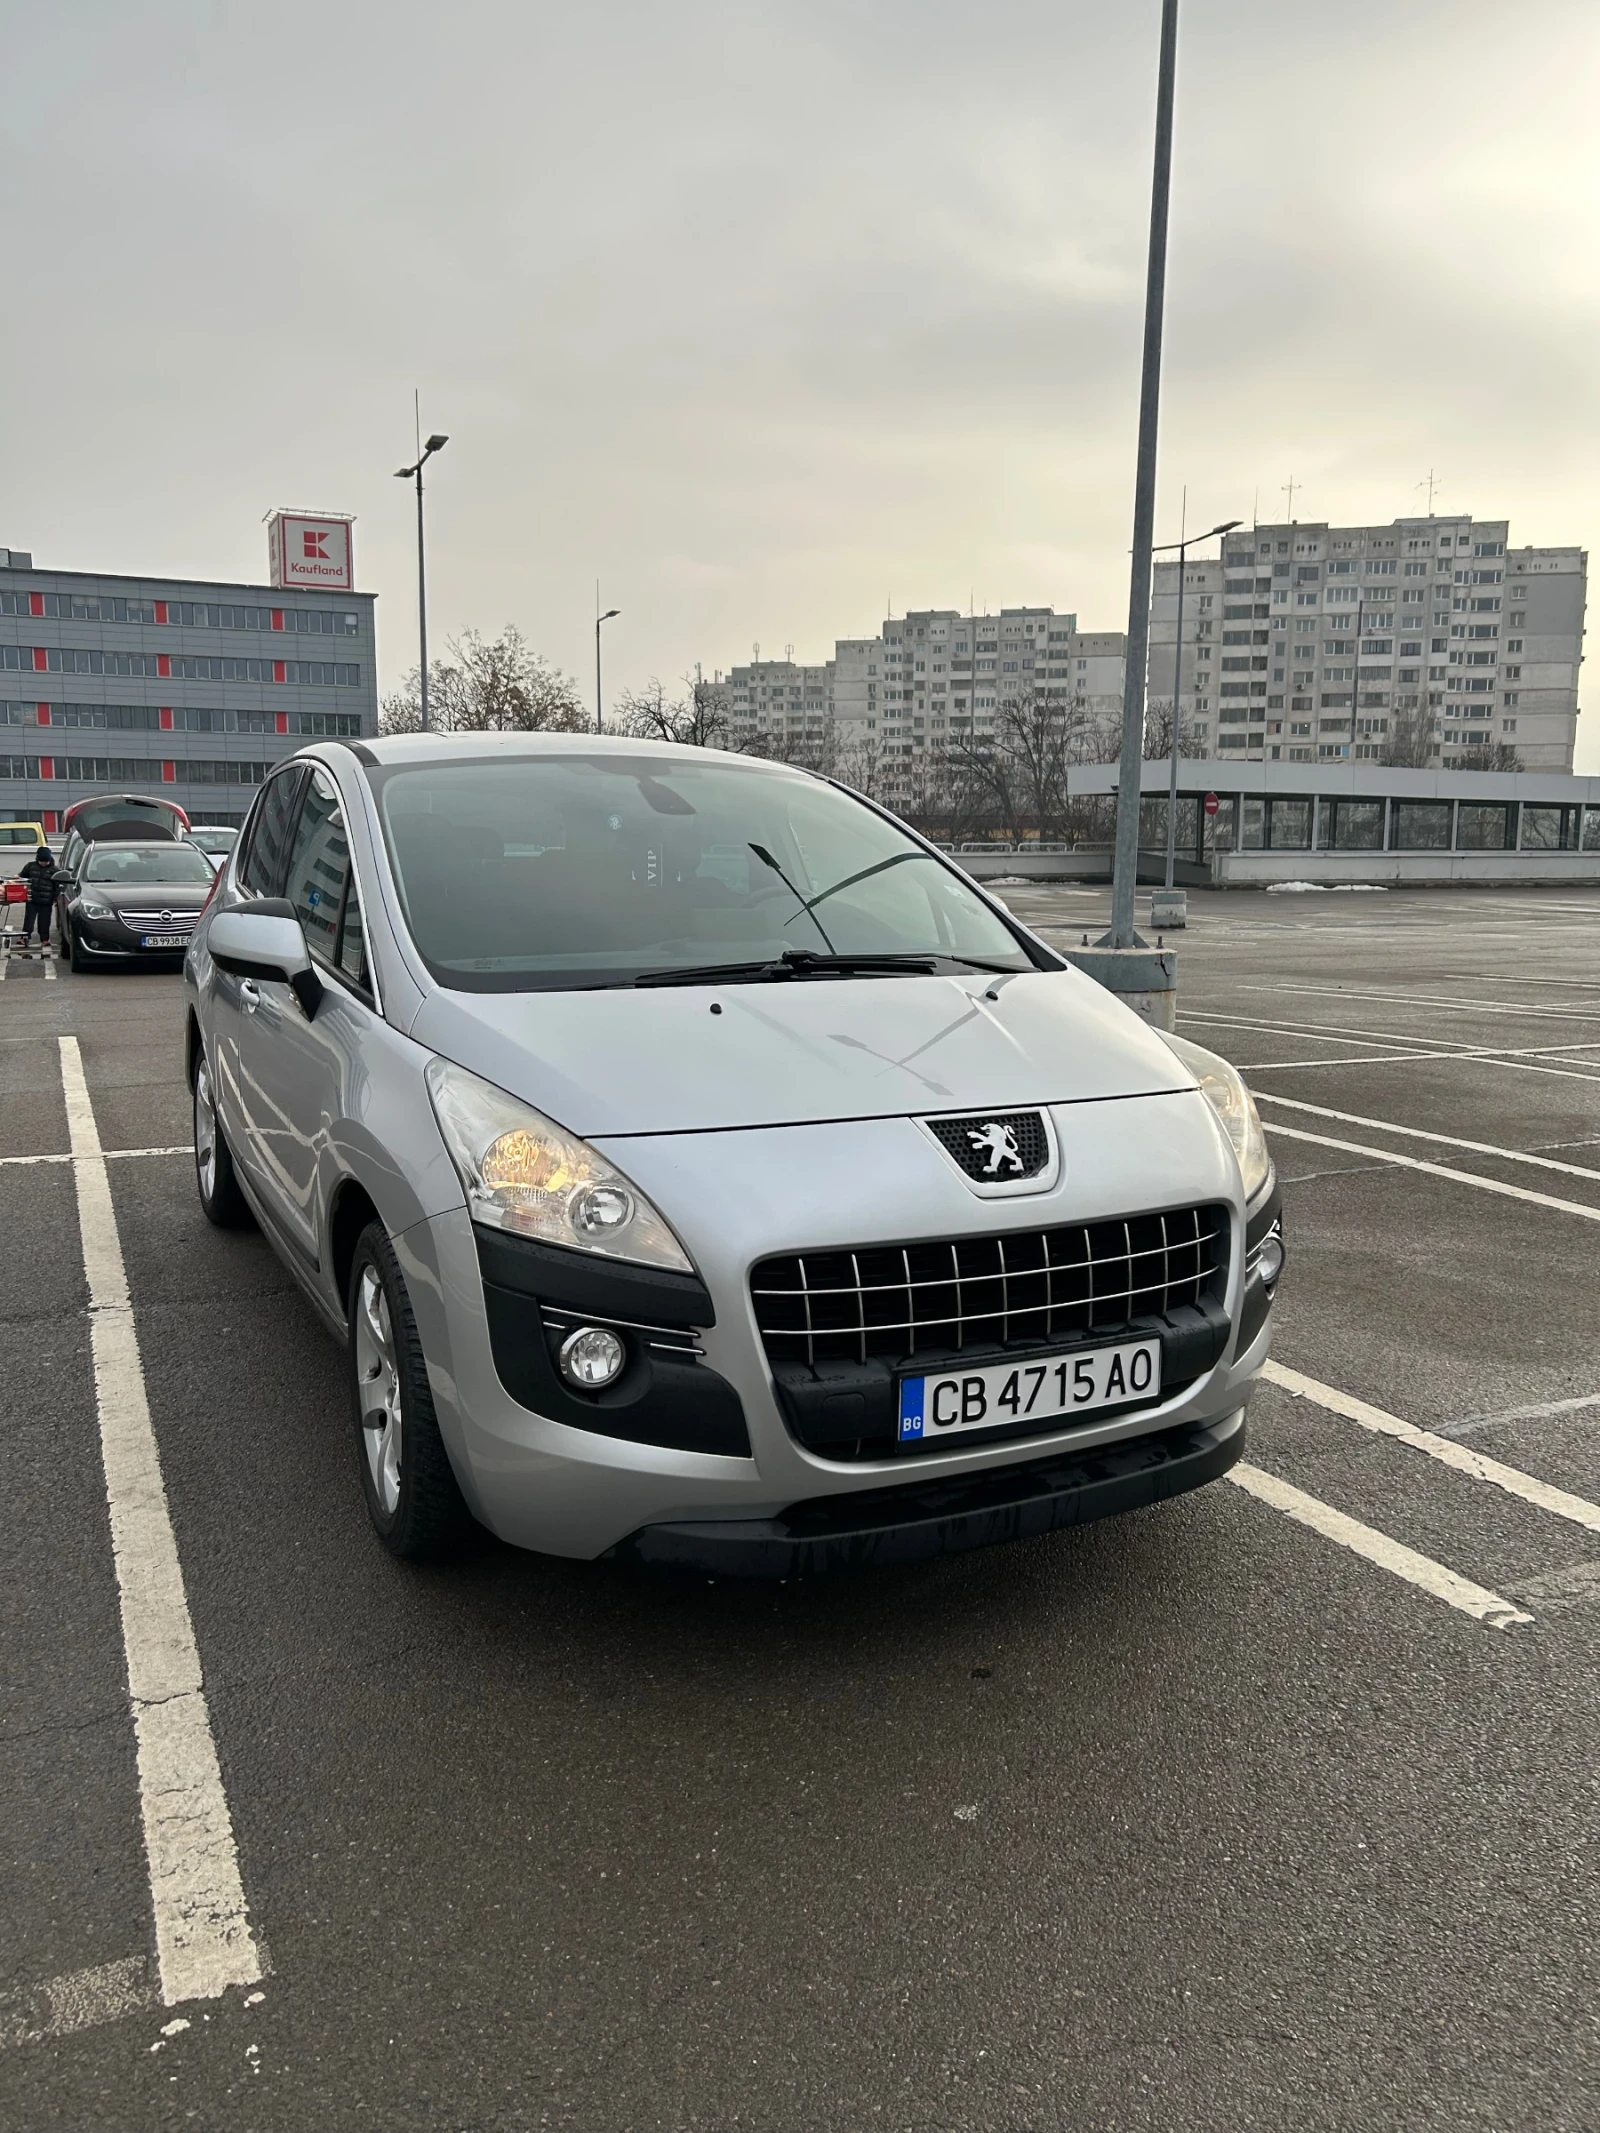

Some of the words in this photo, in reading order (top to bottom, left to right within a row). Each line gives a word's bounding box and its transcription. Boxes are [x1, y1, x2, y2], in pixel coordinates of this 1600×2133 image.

[291, 562, 343, 576] Kaufland
[147, 937, 159, 946] CB
[160, 937, 181, 946] 9938
[932, 1375, 987, 1427] CB
[997, 1357, 1095, 1415] 4715
[903, 1416, 922, 1432] BG
